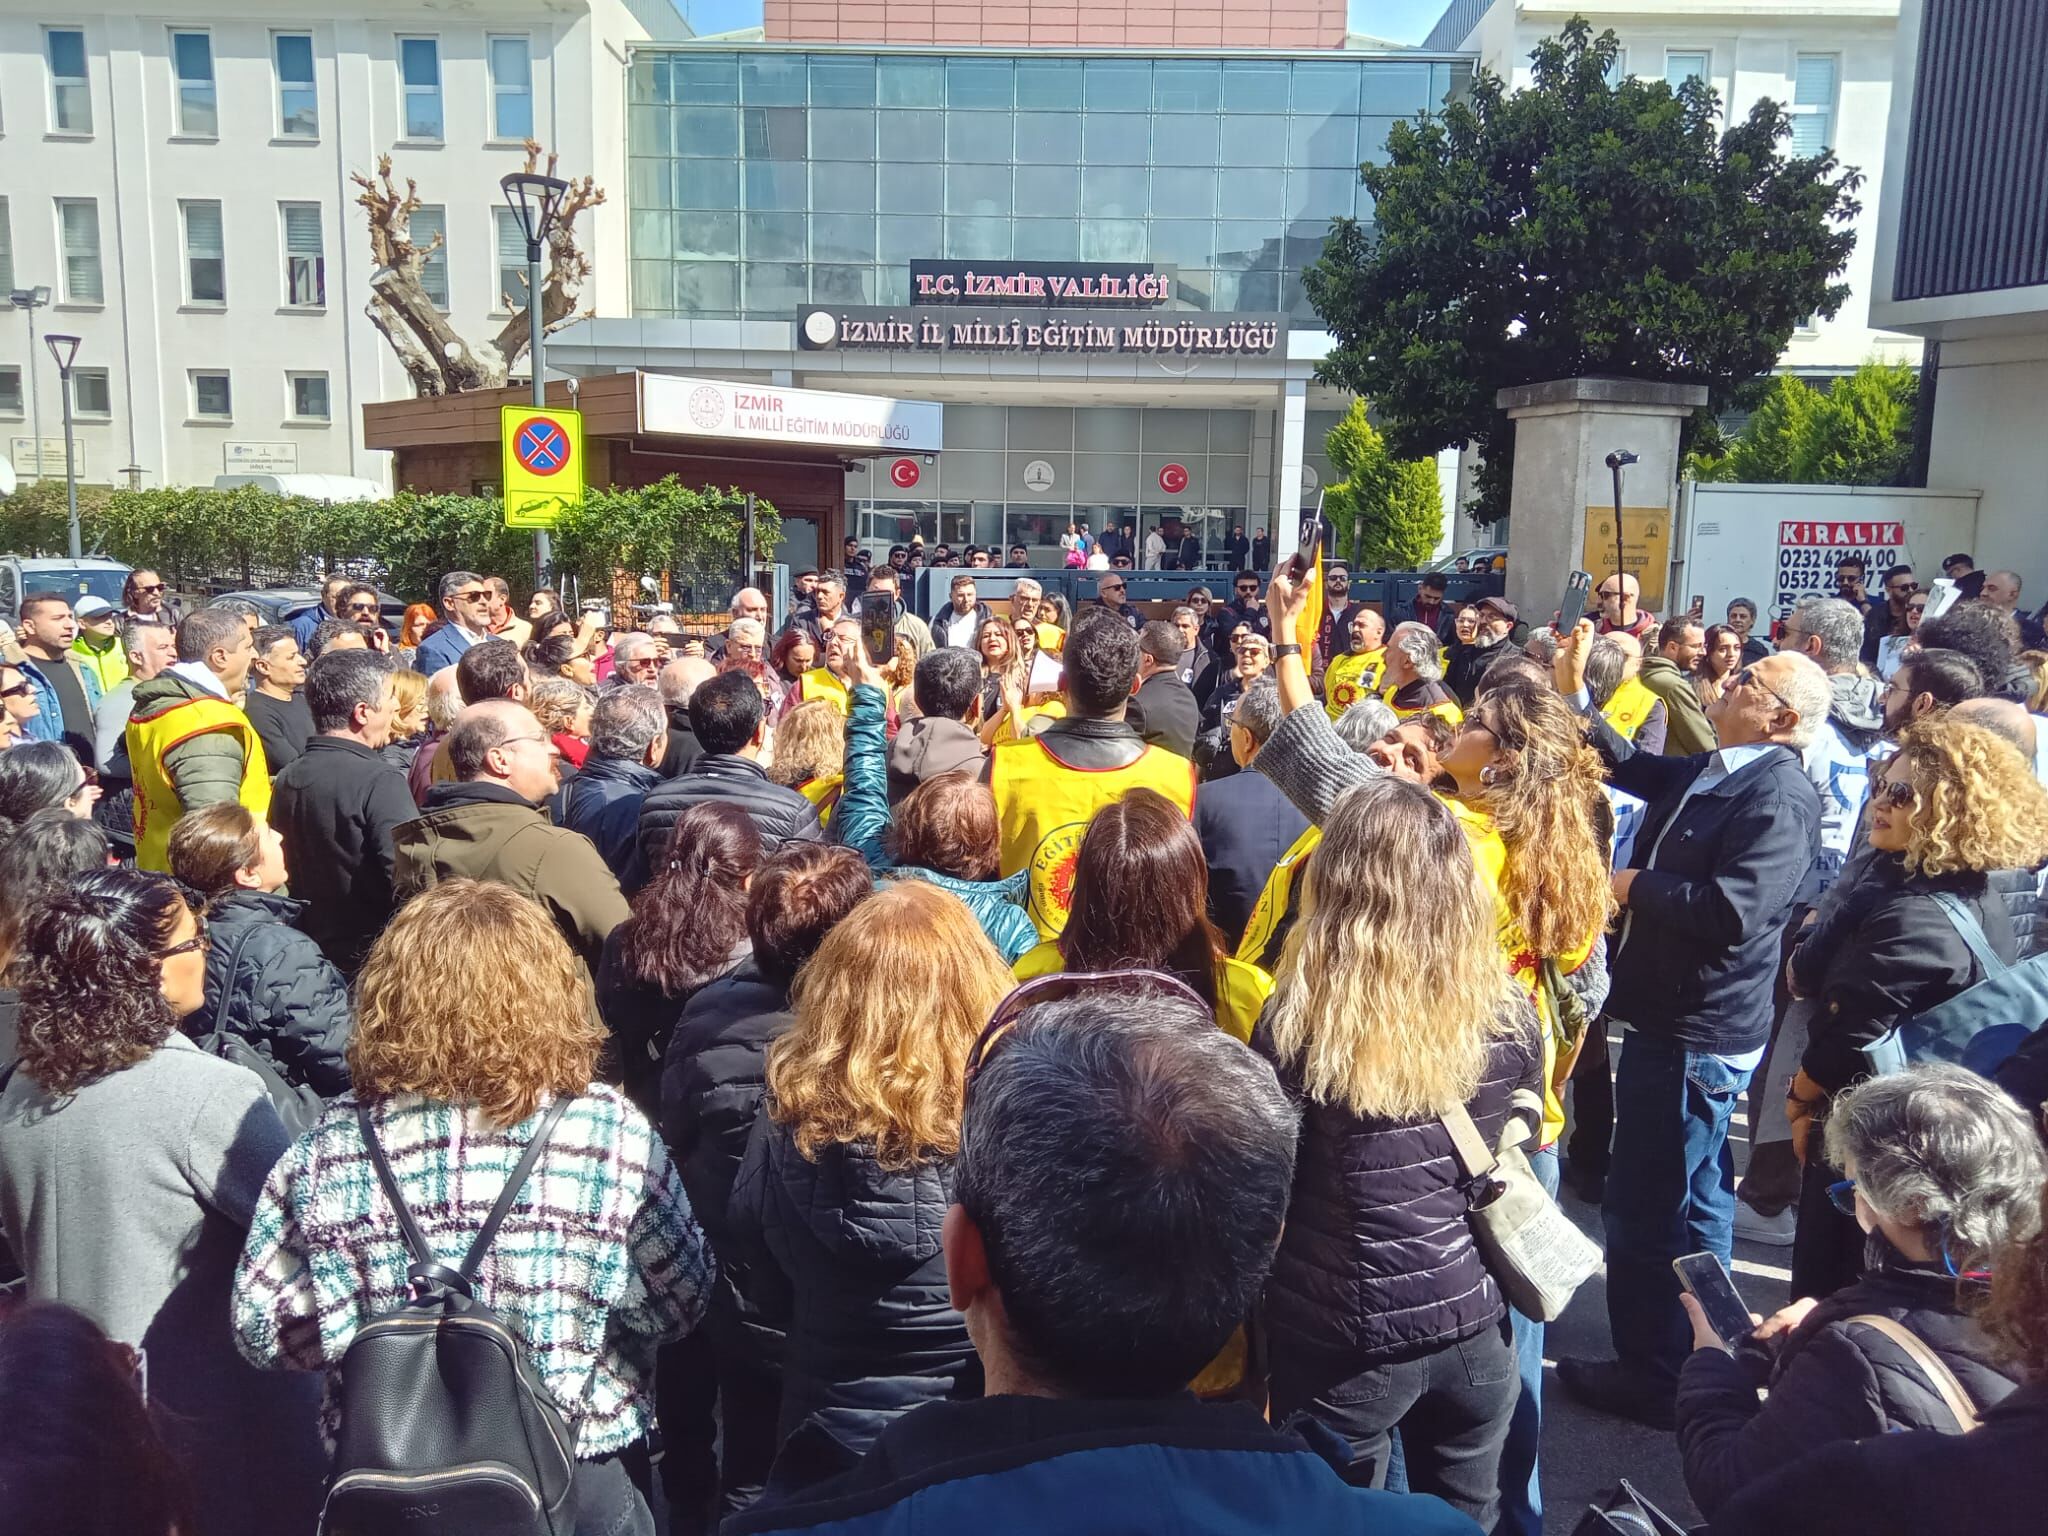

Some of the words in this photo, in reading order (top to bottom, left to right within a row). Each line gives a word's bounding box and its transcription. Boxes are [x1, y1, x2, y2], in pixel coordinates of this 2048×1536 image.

[916, 275, 959, 295] T.C.
[964, 271, 1046, 297] İZMİR
[1048, 273, 1169, 300] VALİLİĞİ
[840, 314, 914, 344] İZMİR
[920, 316, 945, 344] İL
[1026, 319, 1116, 348] EĞİTİM
[1123, 320, 1279, 350] MÜDÜRLÜĞÜ
[734, 391, 783, 412] İZMİR
[734, 412, 745, 429] İL
[787, 416, 829, 435] EĞİTİM
[832, 420, 910, 440] MÜDÜRLÜĞÜ
[1780, 549, 1821, 568] 0232
[1876, 549, 1896, 567] 00
[1779, 571, 1820, 589] 0532
